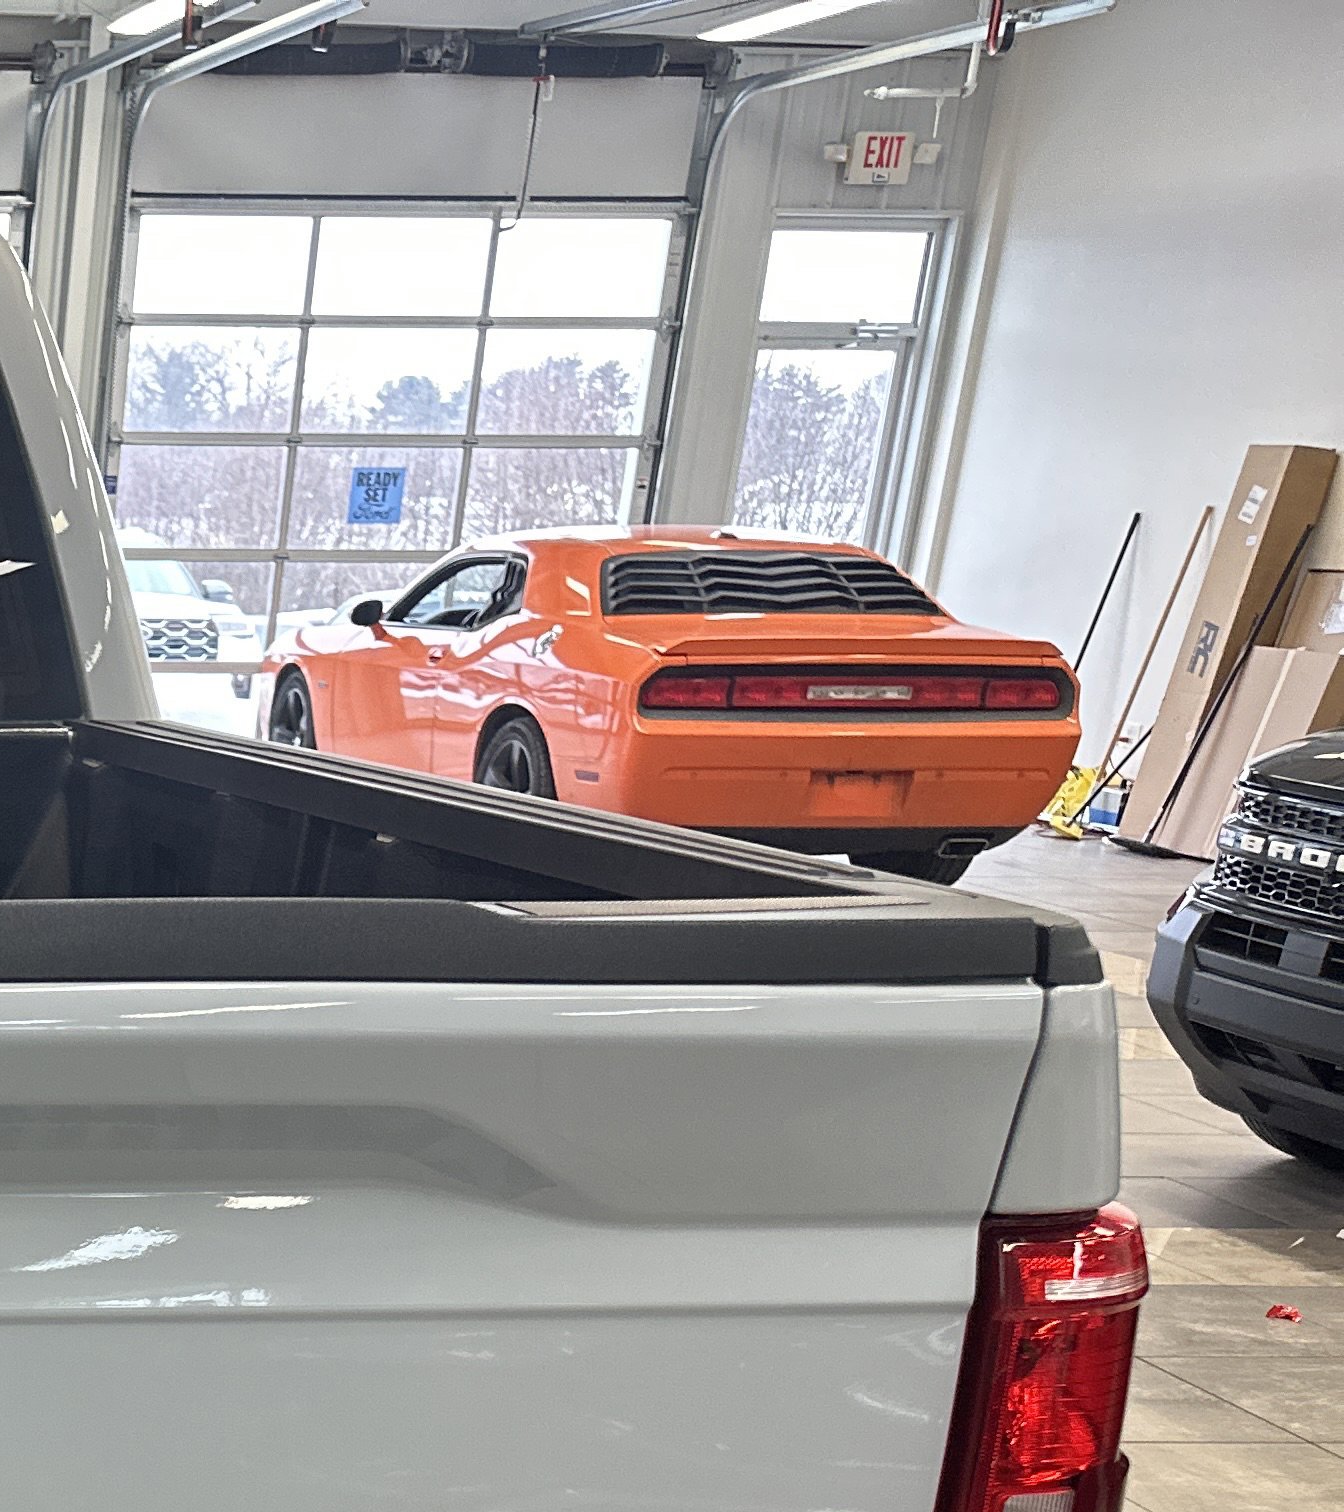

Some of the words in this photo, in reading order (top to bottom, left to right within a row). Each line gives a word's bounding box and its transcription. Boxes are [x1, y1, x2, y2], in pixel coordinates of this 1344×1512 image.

[863, 136, 906, 168] EXIT
[357, 472, 401, 487] READY
[364, 487, 388, 502] SET
[352, 503, 397, 520] Ford
